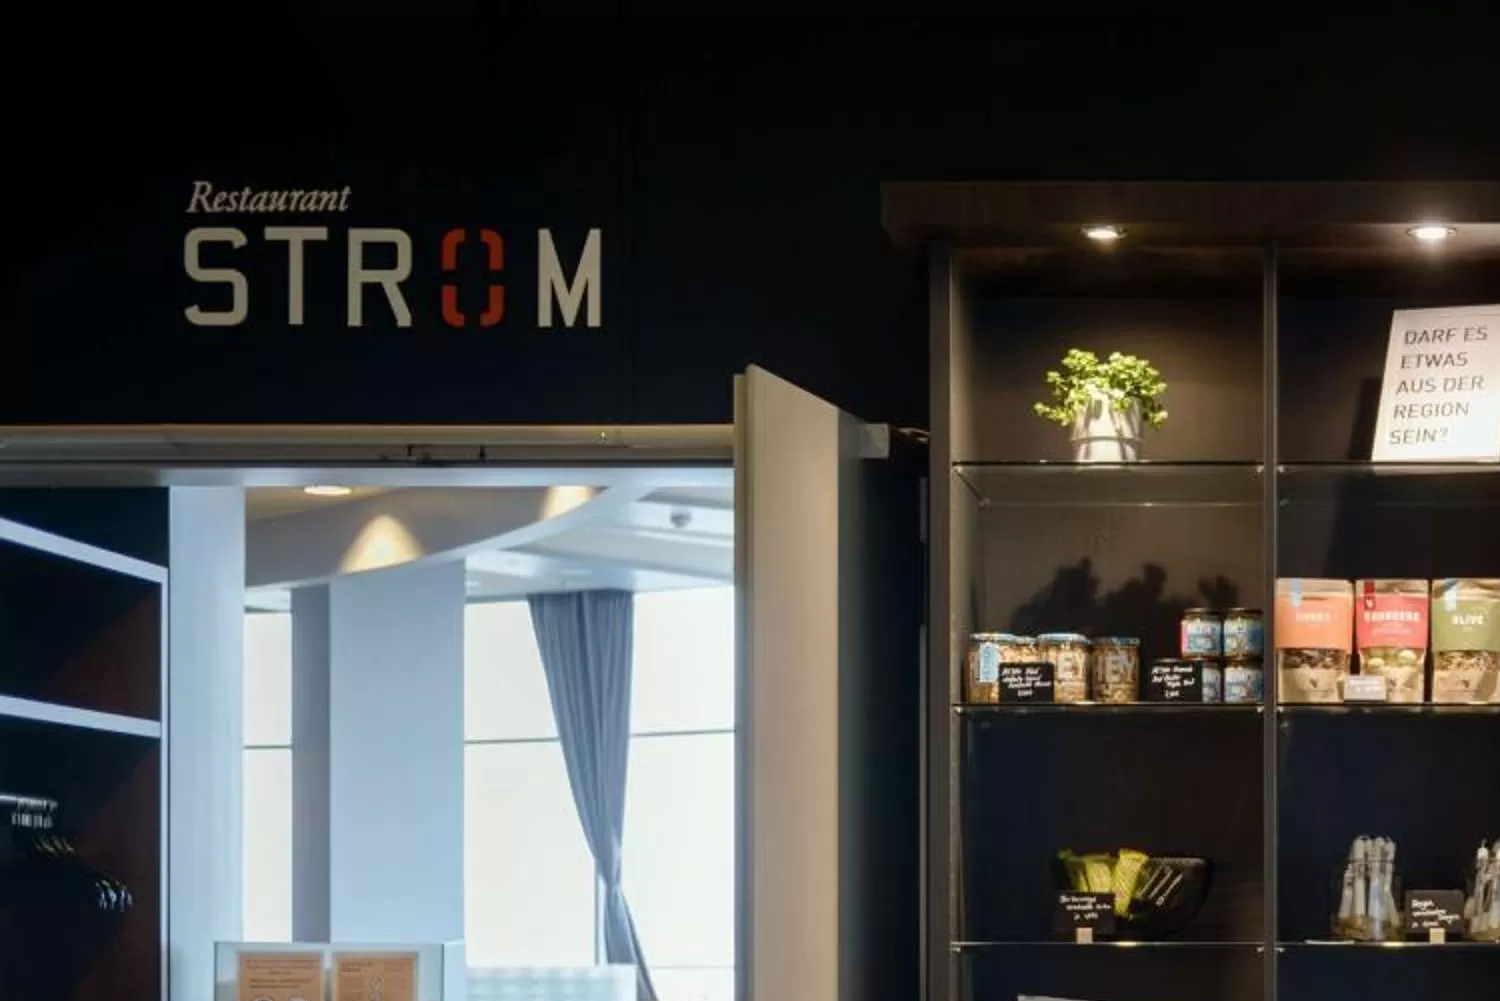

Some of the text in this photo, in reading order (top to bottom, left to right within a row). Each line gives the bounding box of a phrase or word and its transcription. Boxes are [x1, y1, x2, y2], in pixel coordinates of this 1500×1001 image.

[186, 181, 351, 213] Restaurant
[184, 226, 602, 328] STROM
[1404, 327, 1488, 345] DARF ES
[1400, 352, 1468, 369] ETWAS
[1396, 375, 1485, 395] AUS DER
[1393, 402, 1470, 419] REGION
[1388, 427, 1449, 445] SEIN?
